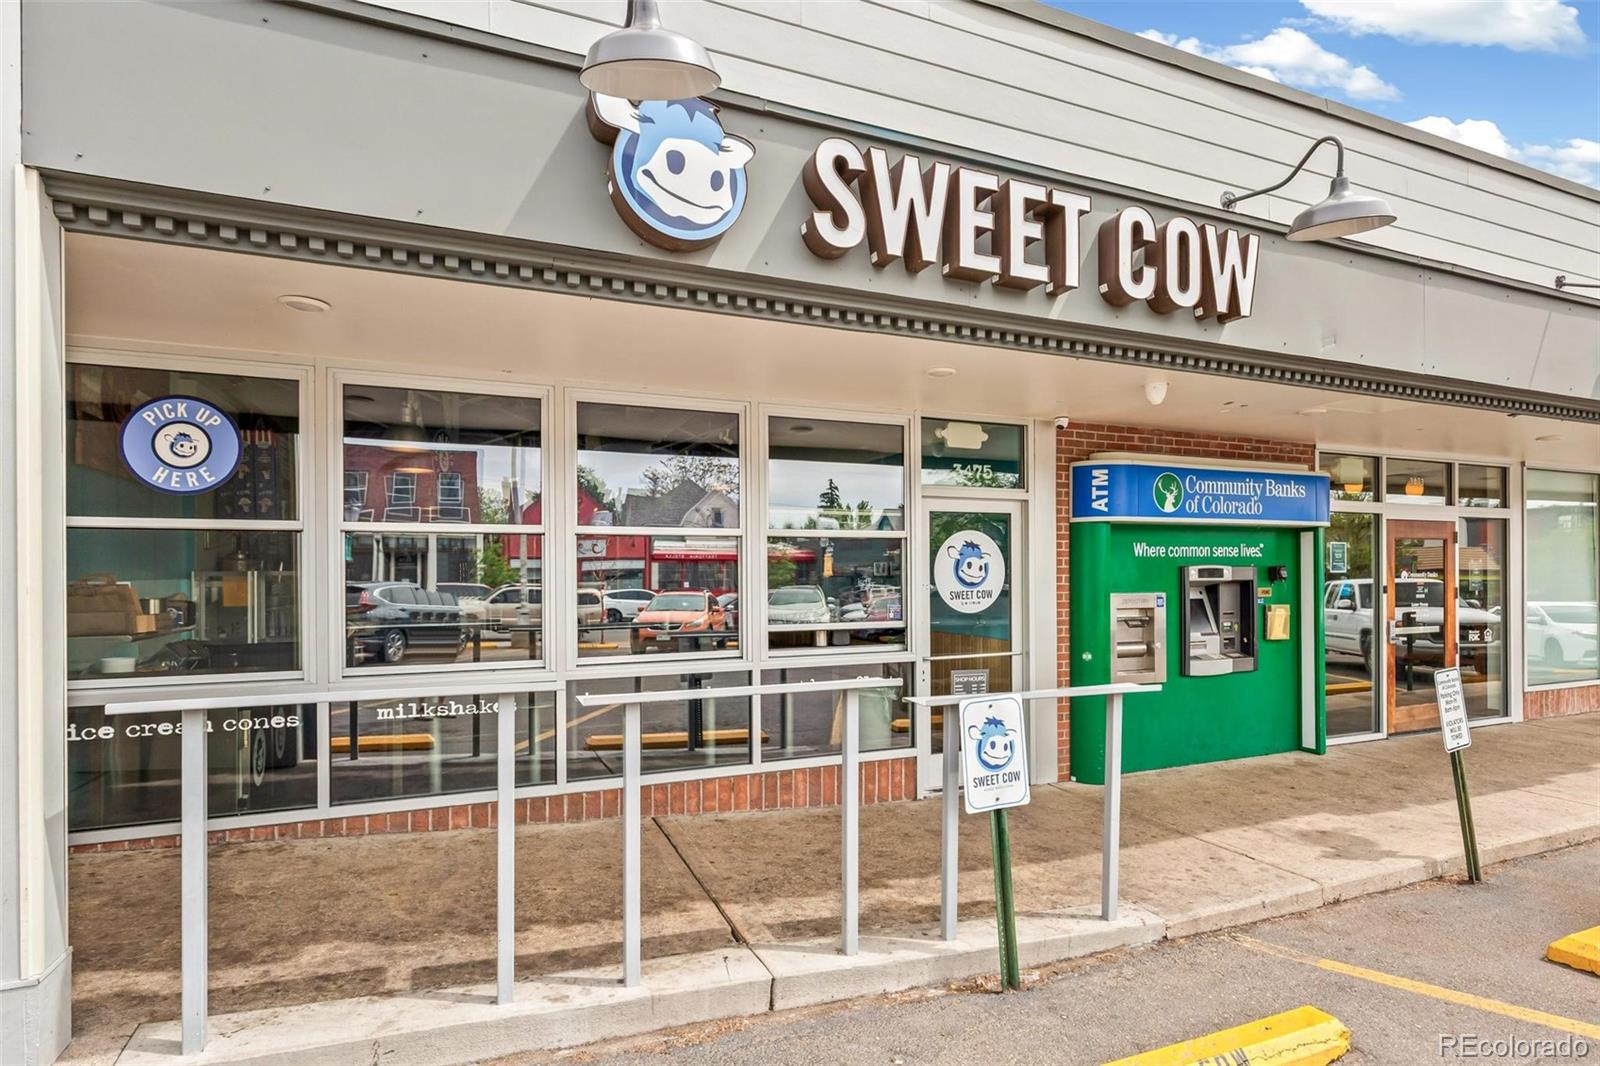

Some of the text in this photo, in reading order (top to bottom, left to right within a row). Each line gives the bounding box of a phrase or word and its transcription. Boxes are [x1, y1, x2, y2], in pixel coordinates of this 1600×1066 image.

[803, 137, 1260, 321] SWEET COW
[142, 402, 222, 427] PICK UP
[152, 466, 216, 488] HERE
[953, 463, 993, 481] 3475
[1091, 468, 1109, 512] ATM
[1185, 474, 1306, 500] Community Banks
[1185, 496, 1263, 515] of Colorado
[1133, 542, 1166, 557] Where
[1167, 545, 1211, 557] common
[1212, 545, 1239, 557] sense
[949, 589, 993, 600] SWEET COW
[67, 723, 115, 741] ice
[222, 714, 301, 732] cones
[973, 774, 999, 788] SWEET
[1002, 770, 1021, 783] COW
